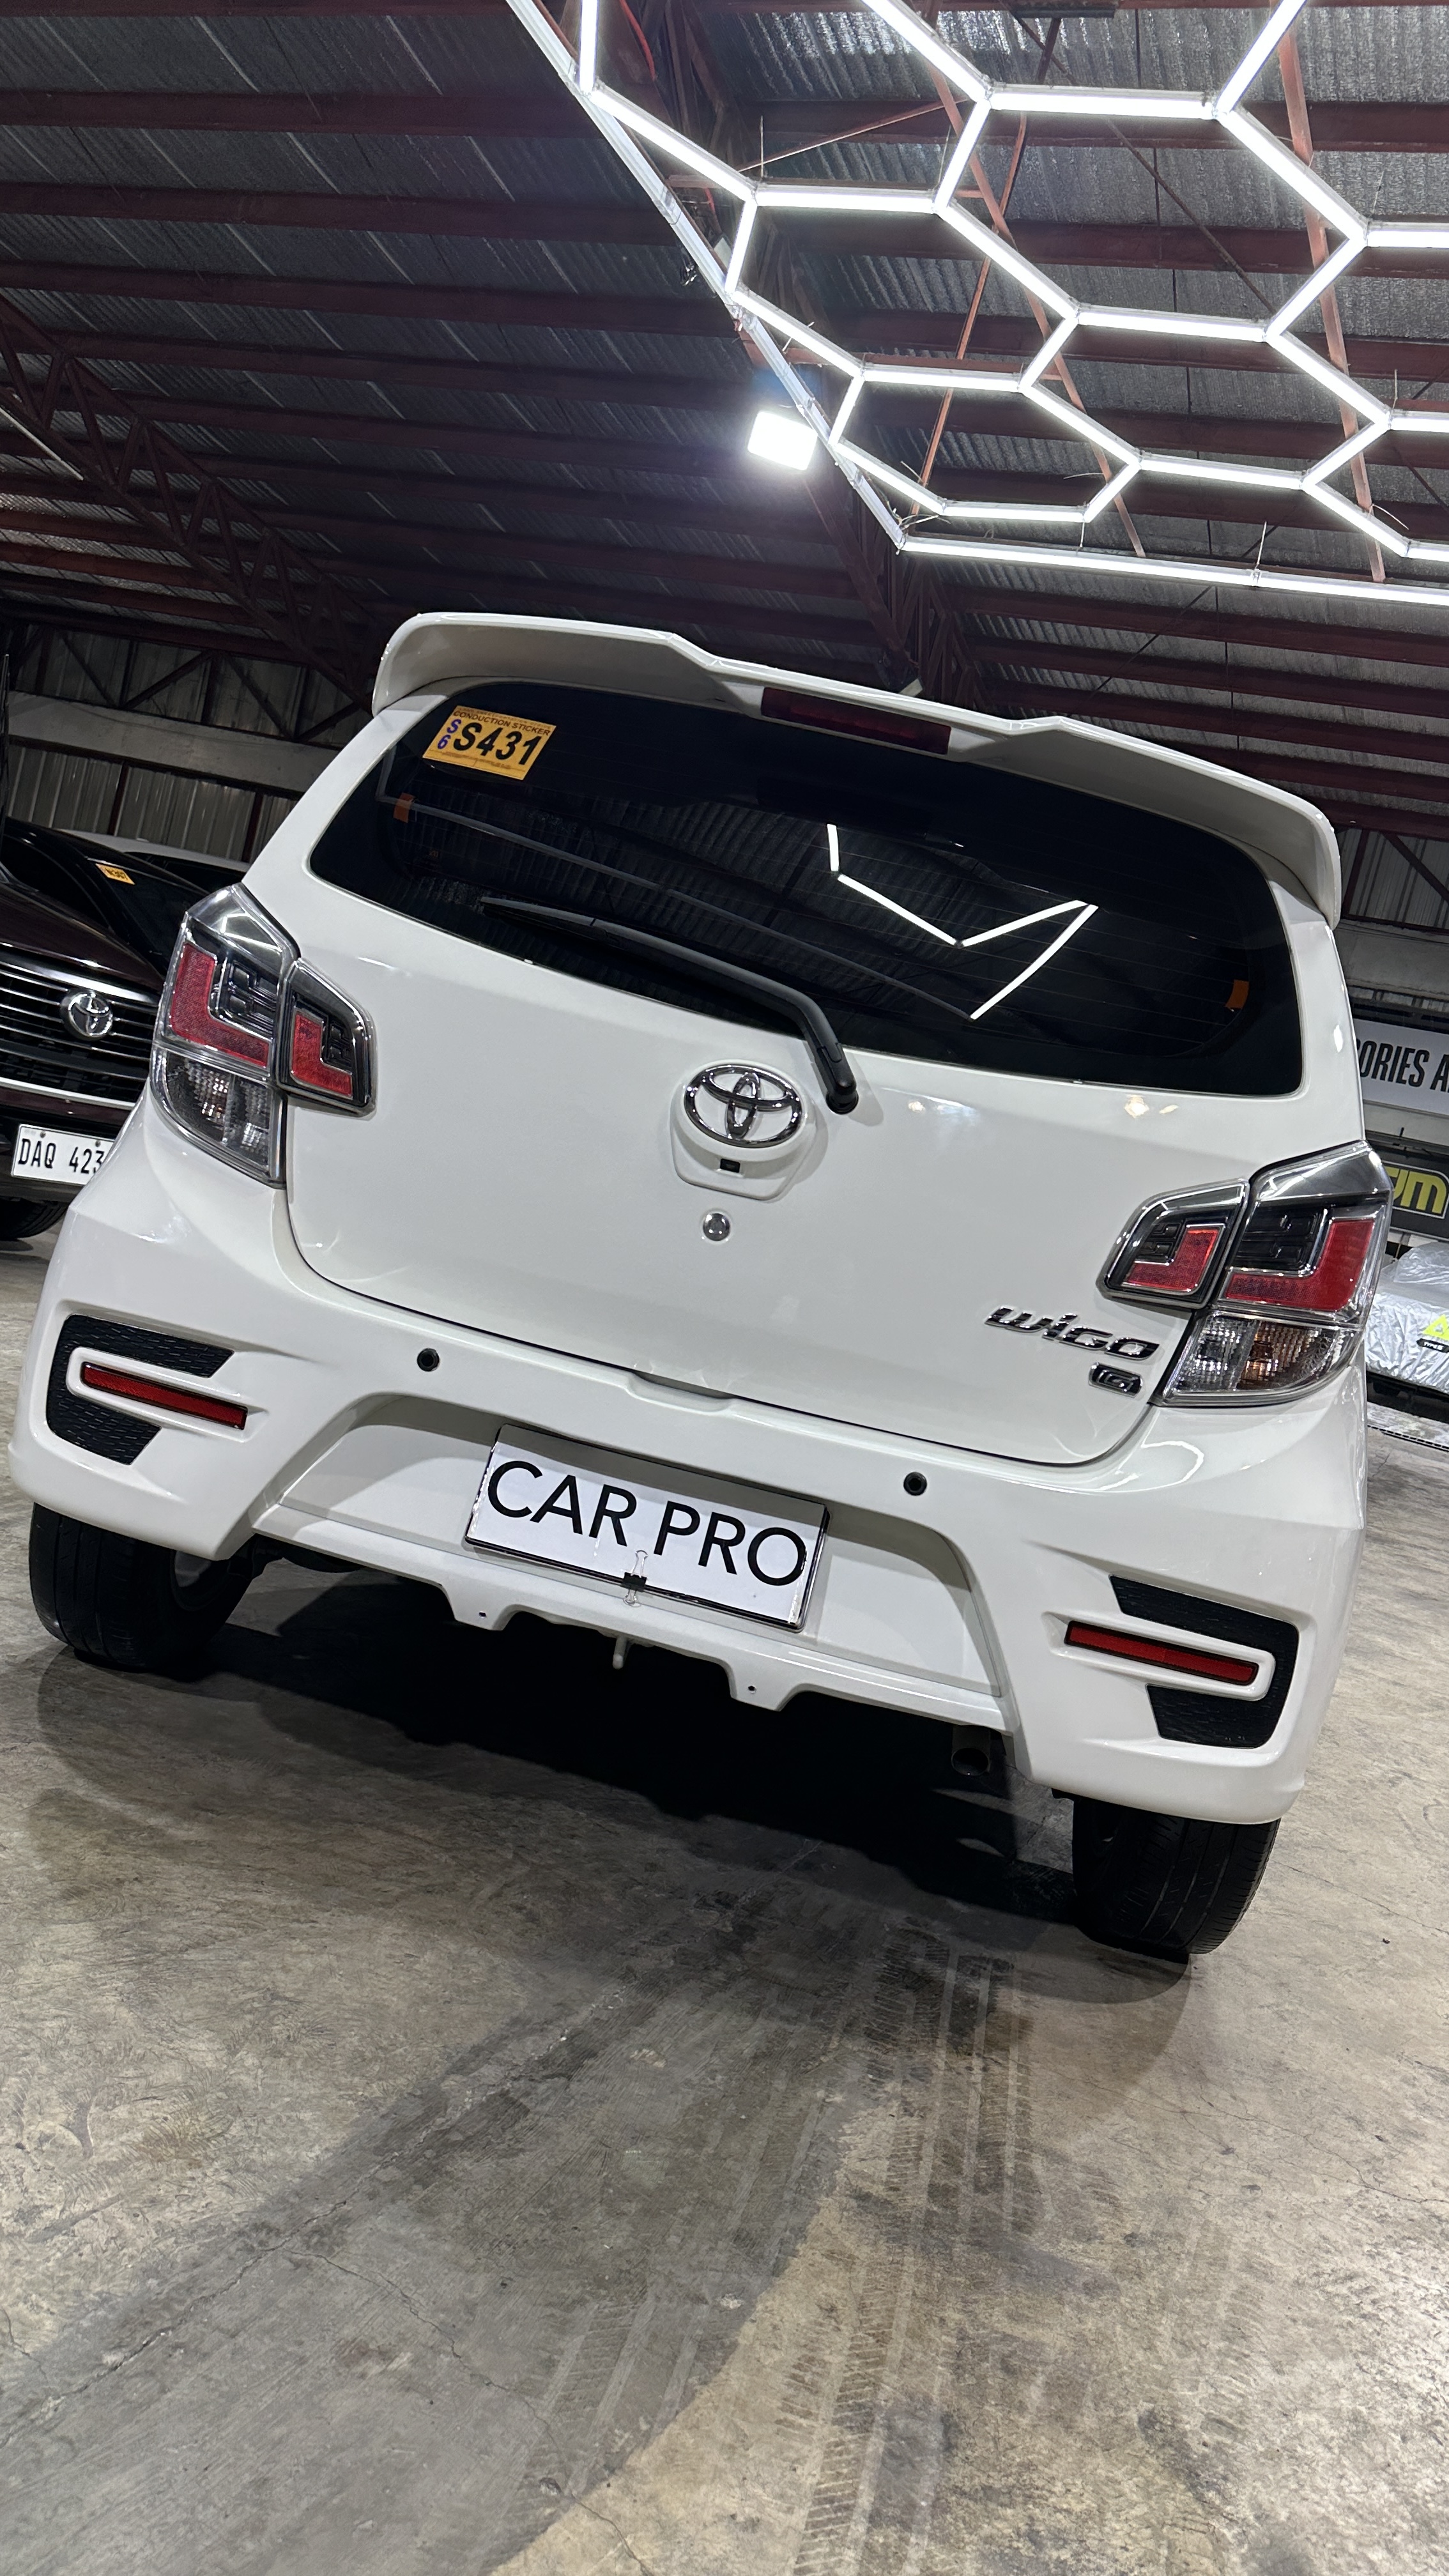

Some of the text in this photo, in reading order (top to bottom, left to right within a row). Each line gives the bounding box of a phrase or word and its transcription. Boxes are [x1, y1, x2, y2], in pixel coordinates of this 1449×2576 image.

[447, 719, 461, 733] S
[453, 710, 510, 727] CONDUCTION
[512, 723, 551, 736] STICKER
[437, 735, 450, 749] 6
[453, 723, 542, 765] S431
[1356, 1038, 1430, 1087] ORIES
[18, 1138, 56, 1169] DAQ
[487, 1460, 806, 1586] CAR PRO
